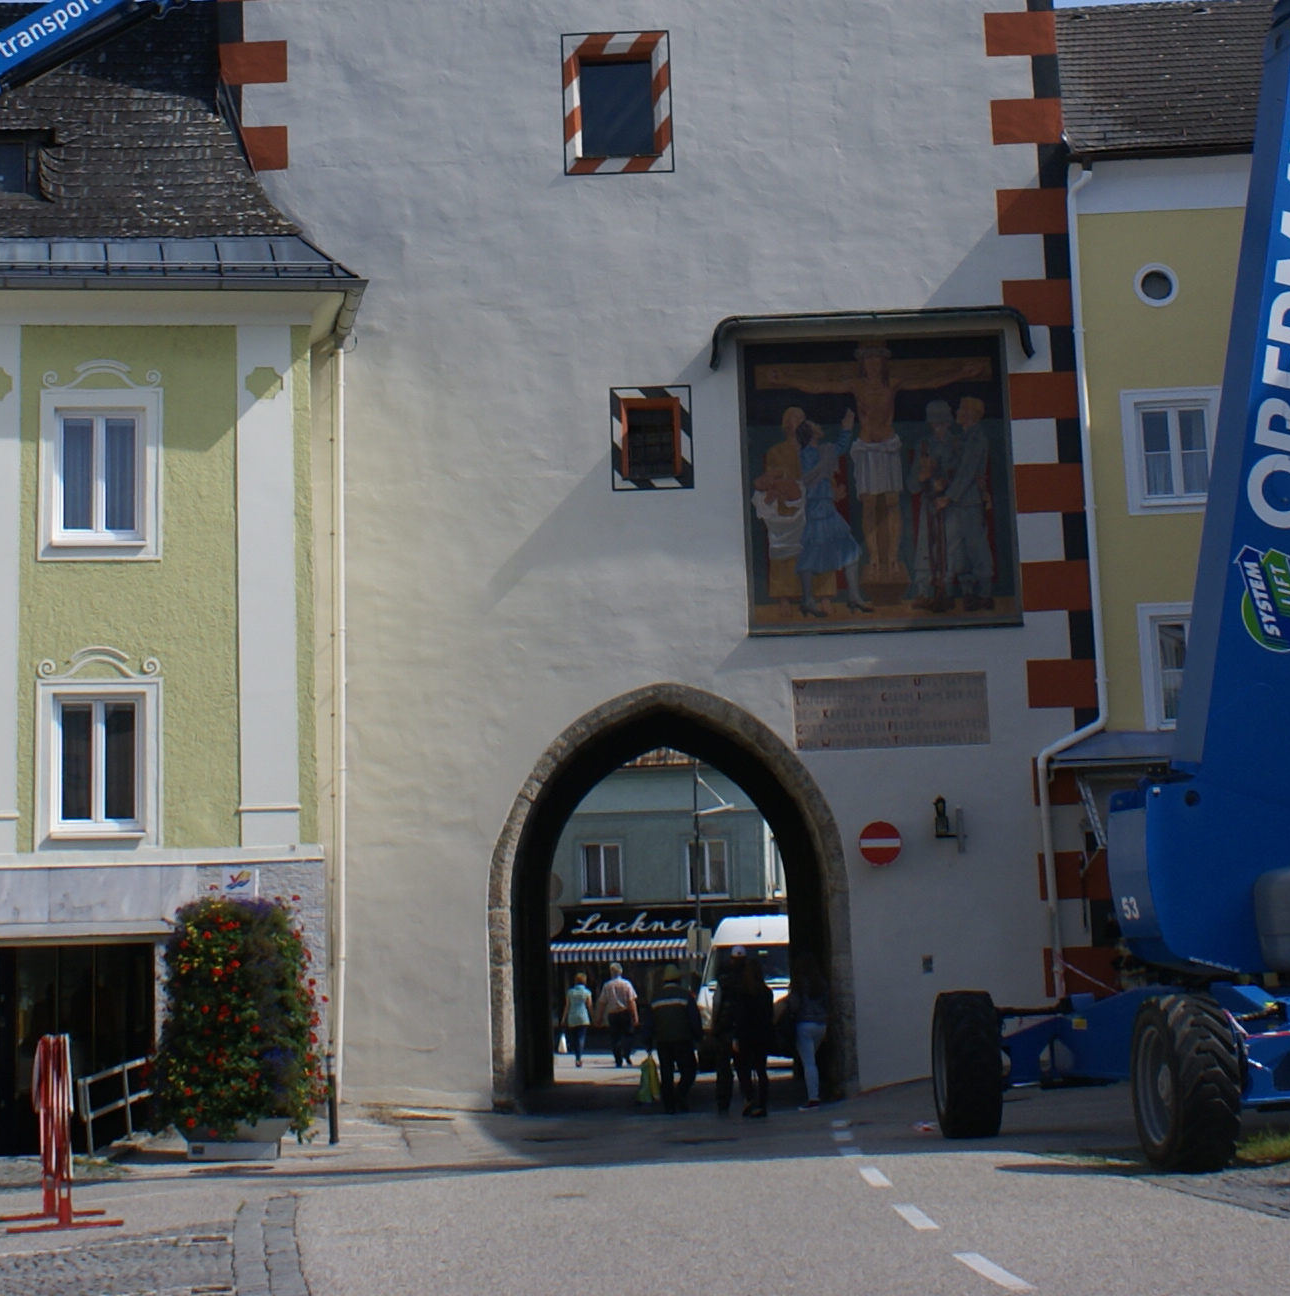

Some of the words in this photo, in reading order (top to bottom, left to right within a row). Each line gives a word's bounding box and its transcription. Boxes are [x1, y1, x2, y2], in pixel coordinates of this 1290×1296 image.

[1242, 561, 1282, 638] SYSTEM
[1121, 896, 1140, 920] 53
[571, 910, 699, 935] Lackner
